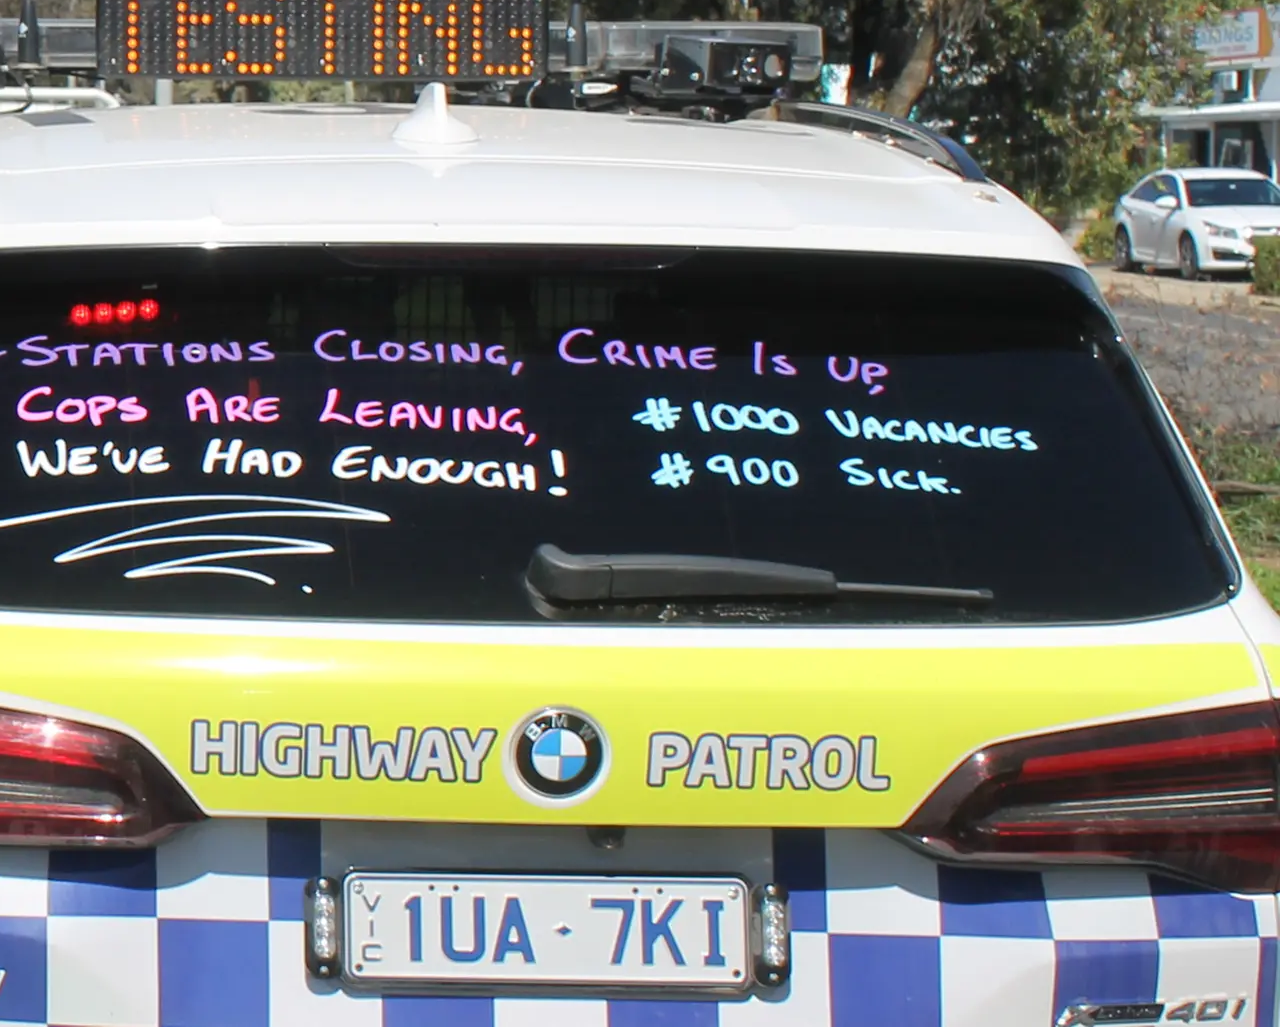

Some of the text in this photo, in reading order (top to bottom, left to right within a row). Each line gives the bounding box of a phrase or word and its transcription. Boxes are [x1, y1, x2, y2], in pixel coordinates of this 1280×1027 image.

[185, 386, 280, 424] ARE
[202, 437, 303, 478] HAD
[524, 713, 596, 742] BMW
[191, 720, 890, 791] HIGHWAY PATROL
